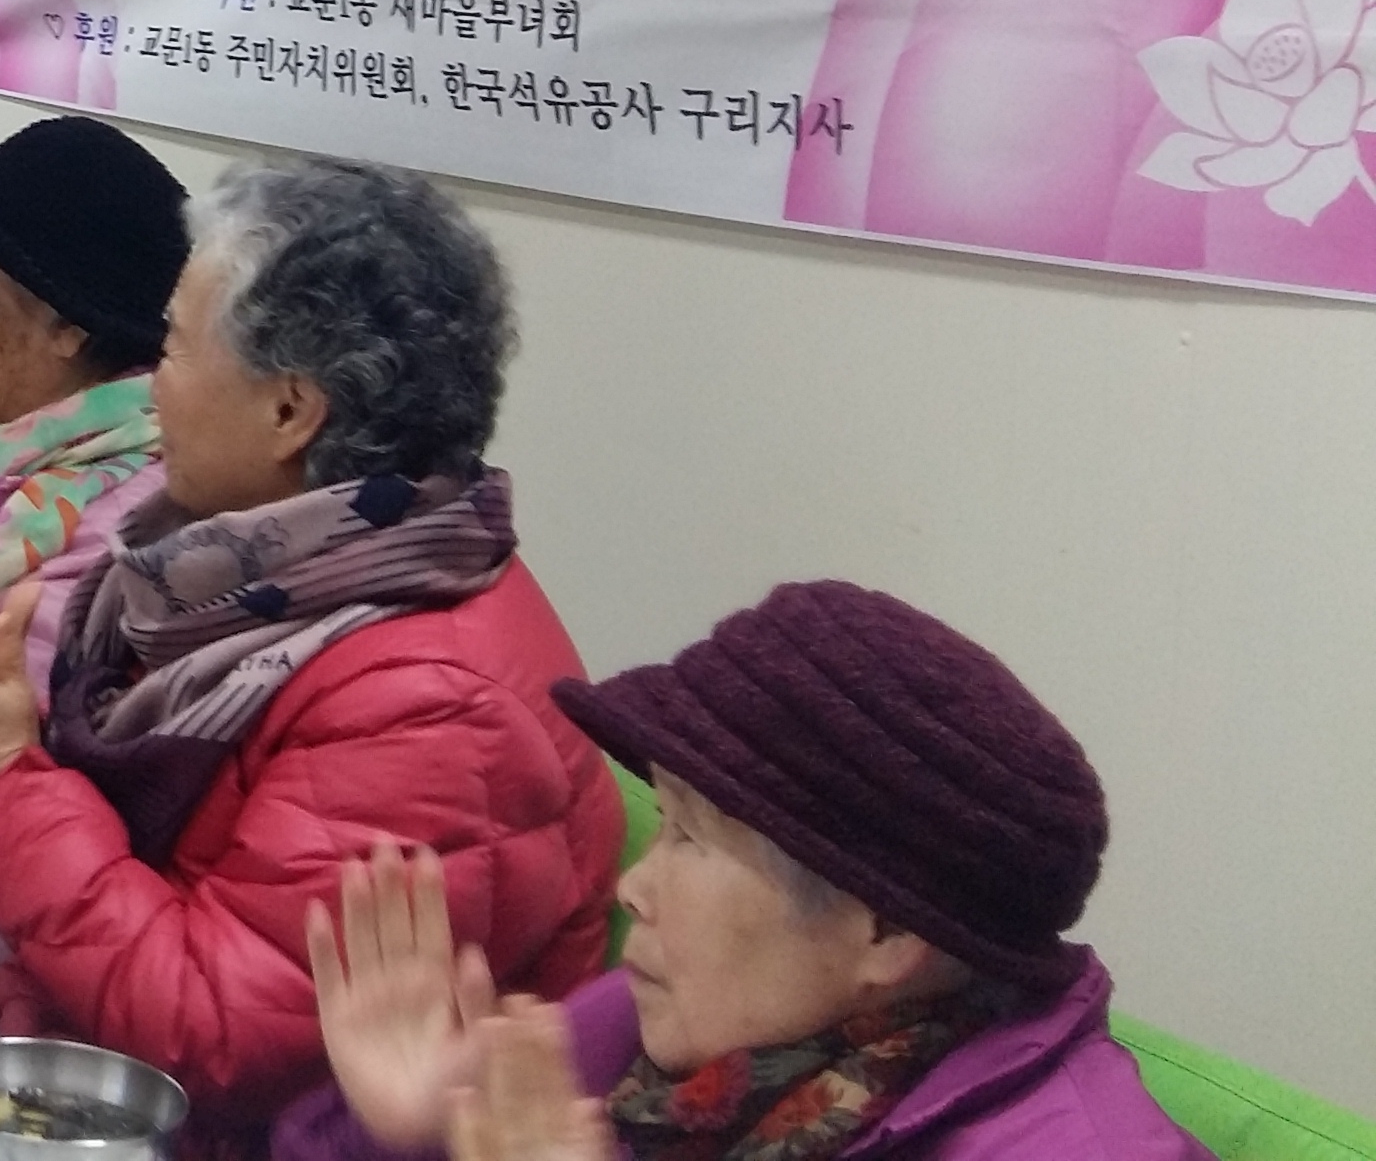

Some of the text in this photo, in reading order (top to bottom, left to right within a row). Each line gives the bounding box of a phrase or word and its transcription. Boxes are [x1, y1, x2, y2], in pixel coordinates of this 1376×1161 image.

[74, 12, 119, 56] 후원
[139, 25, 216, 74] 교문1동
[441, 62, 665, 136] 한국석유공사
[679, 86, 854, 156] 구리지사
